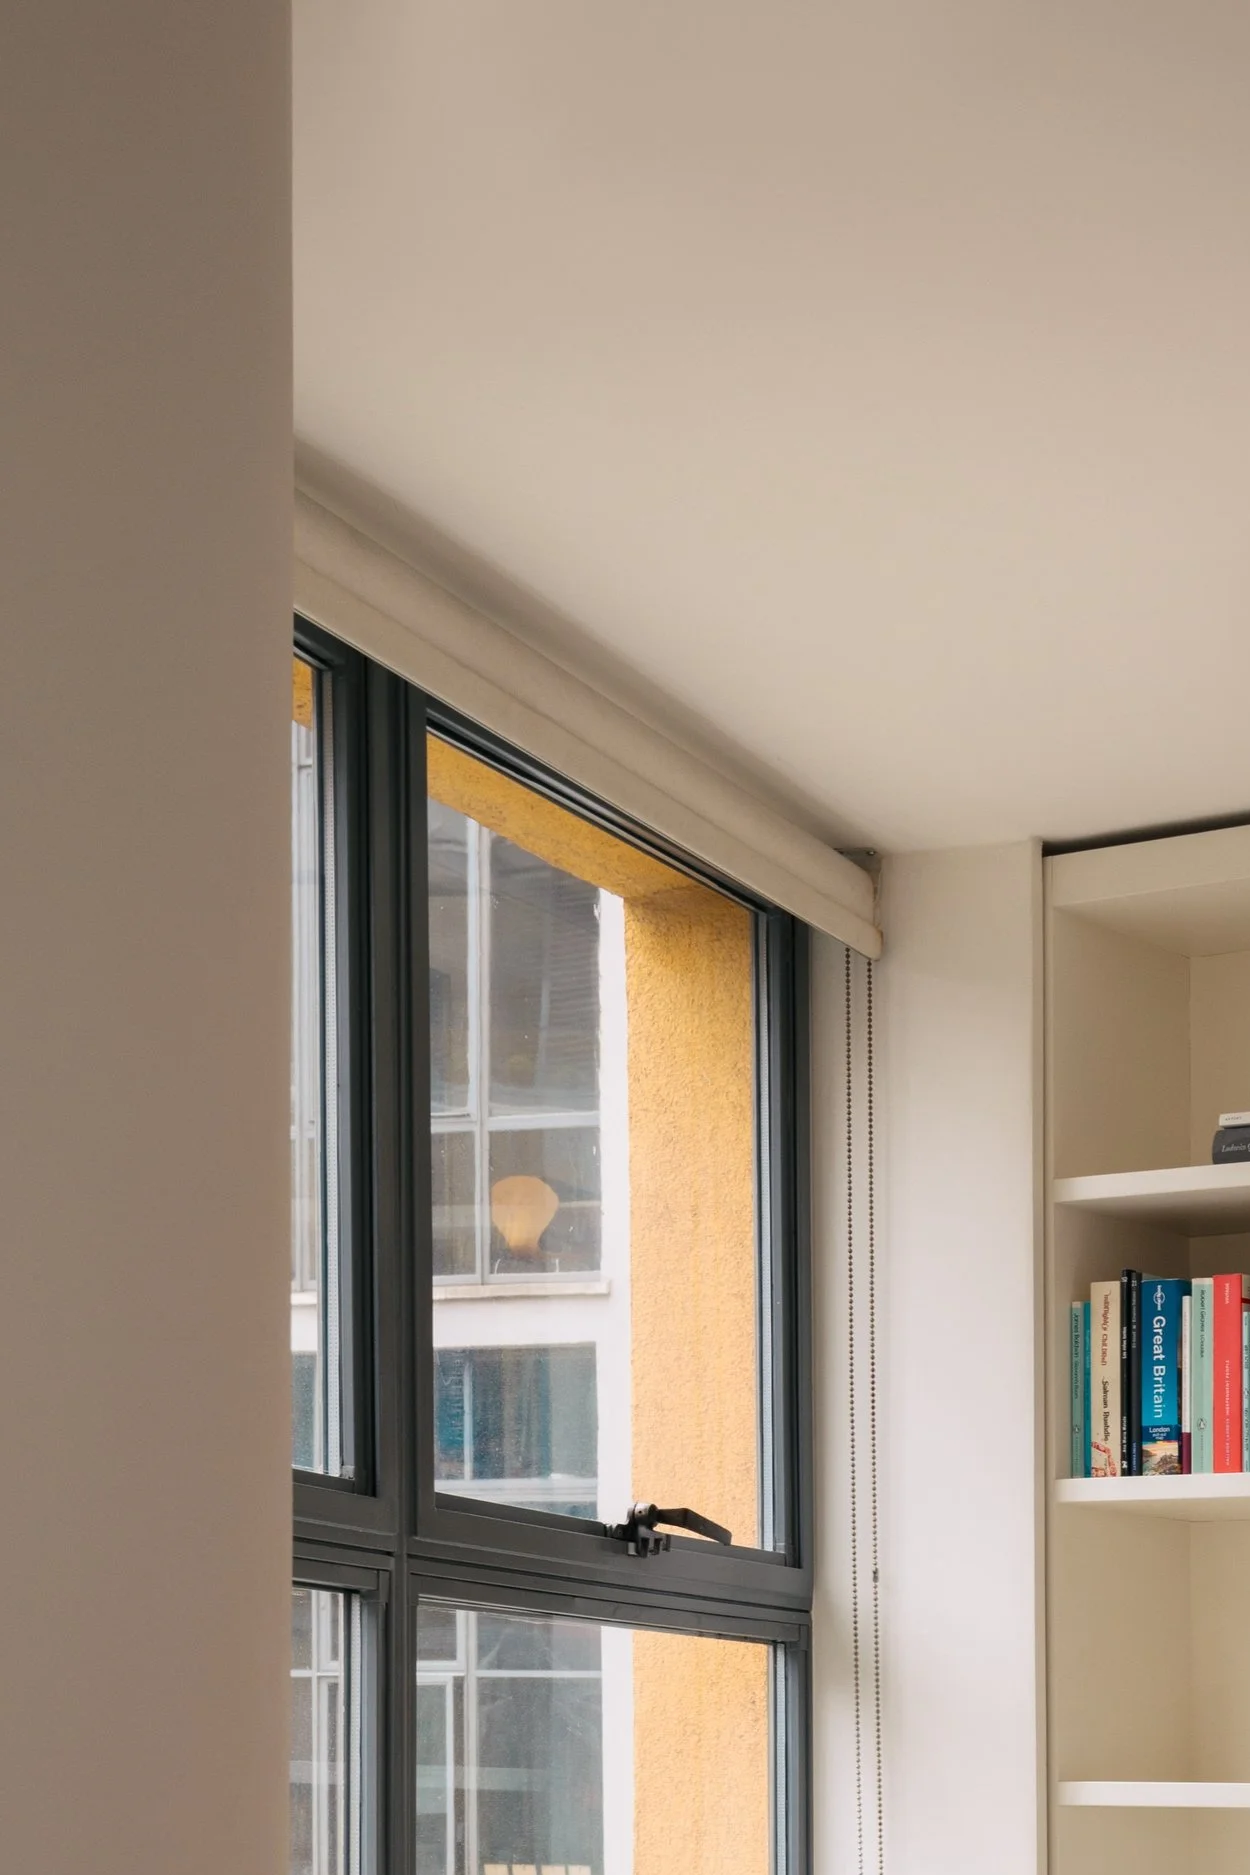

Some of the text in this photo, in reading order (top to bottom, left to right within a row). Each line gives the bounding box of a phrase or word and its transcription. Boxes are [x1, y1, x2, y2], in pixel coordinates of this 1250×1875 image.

[1153, 1315, 1166, 1361] Great
[1102, 1377, 1110, 1408] Salman
[1153, 1365, 1166, 1418] Britain
